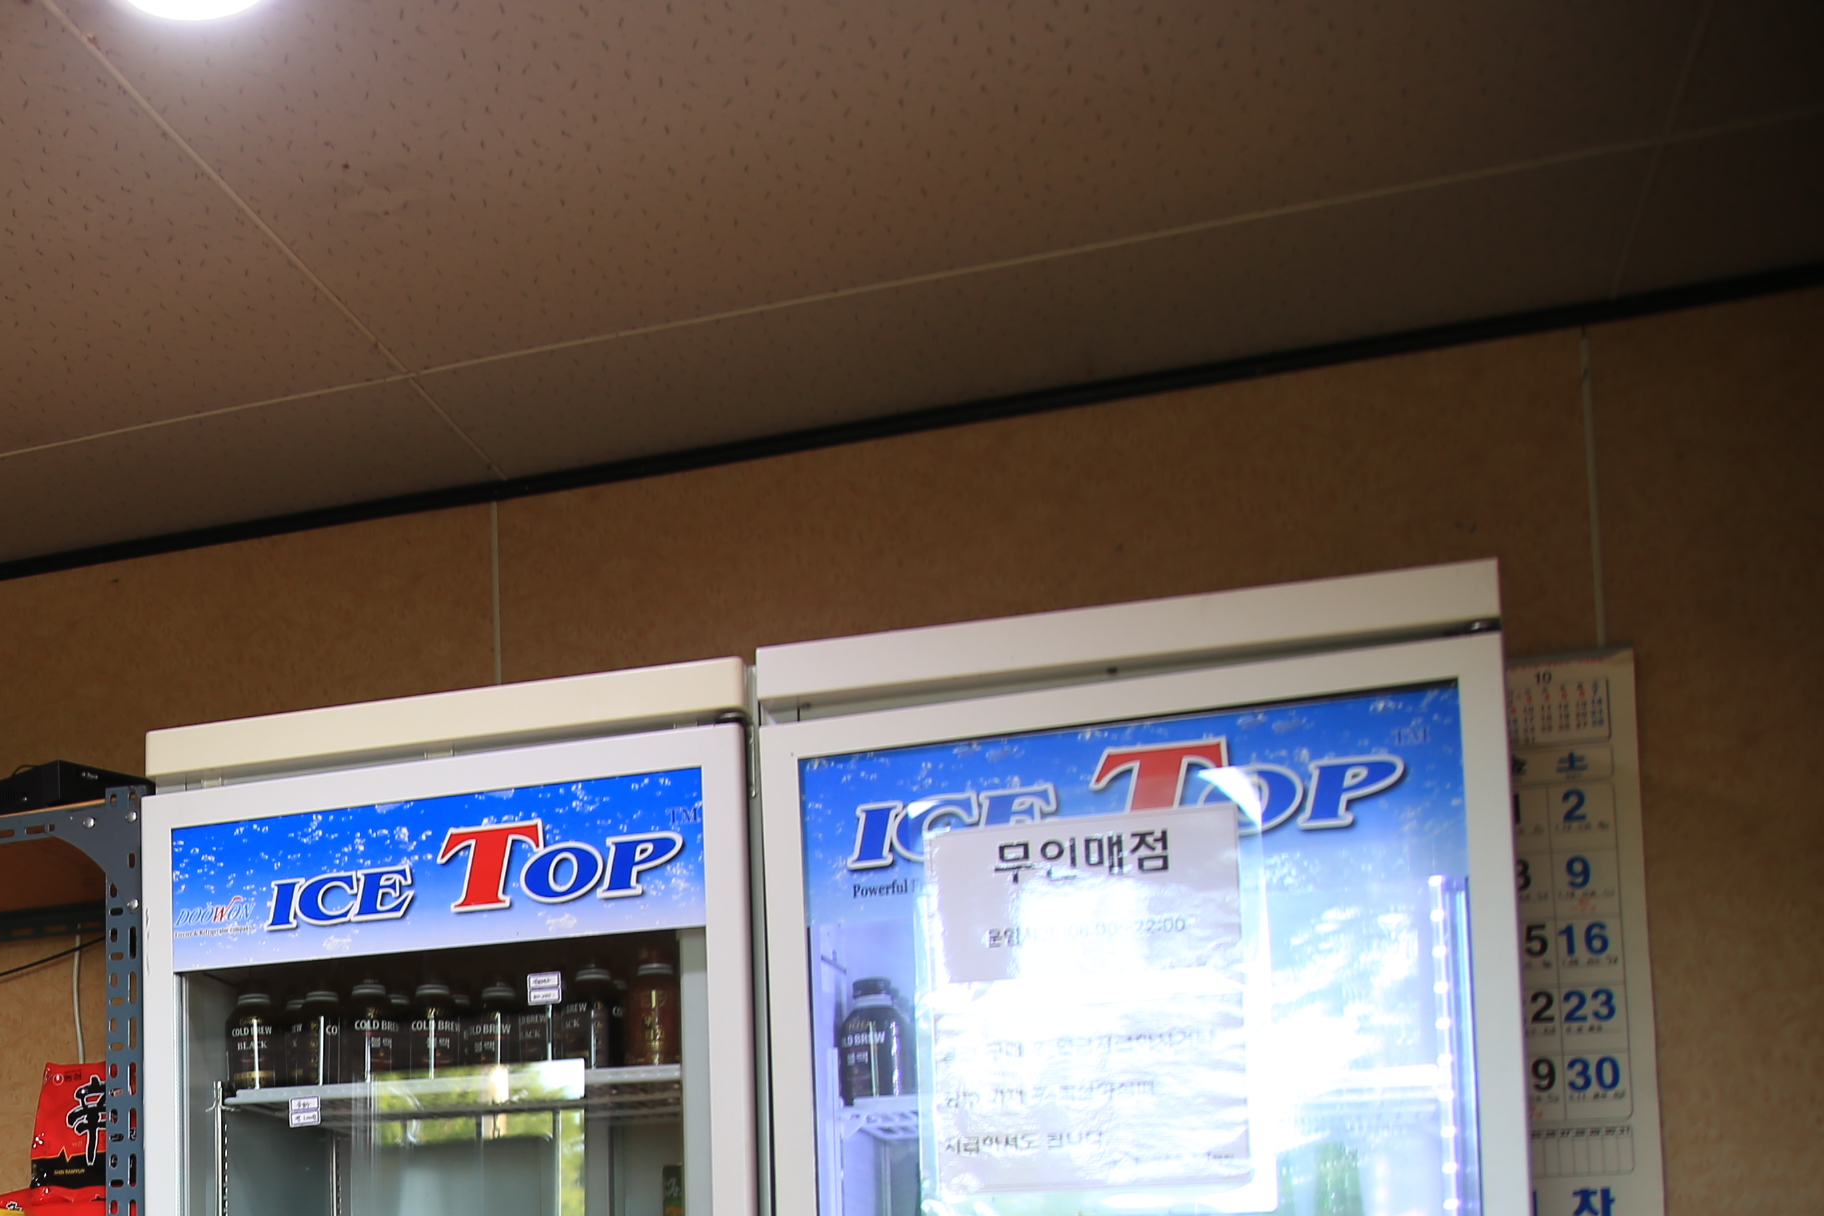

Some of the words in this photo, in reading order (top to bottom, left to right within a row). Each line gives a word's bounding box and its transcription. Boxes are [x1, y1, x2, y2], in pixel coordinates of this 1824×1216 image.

[1536, 671, 1552, 685] 10
[666, 806, 700, 825] TM
[1561, 788, 1588, 824] 2
[993, 828, 1170, 884] 무인매점
[1565, 855, 1592, 890] 9
[266, 864, 415, 931] ICE
[852, 879, 909, 899] Powerful
[175, 896, 256, 927] DOOWON
[1557, 920, 1610, 957] 16
[1562, 988, 1617, 1023] 23
[232, 1027, 249, 1037] COLD
[354, 1018, 380, 1031] COLD
[411, 1019, 436, 1031] COLD
[438, 1019, 461, 1032] BREW
[237, 1041, 267, 1051] BLACK
[1566, 1056, 1621, 1093] 30
